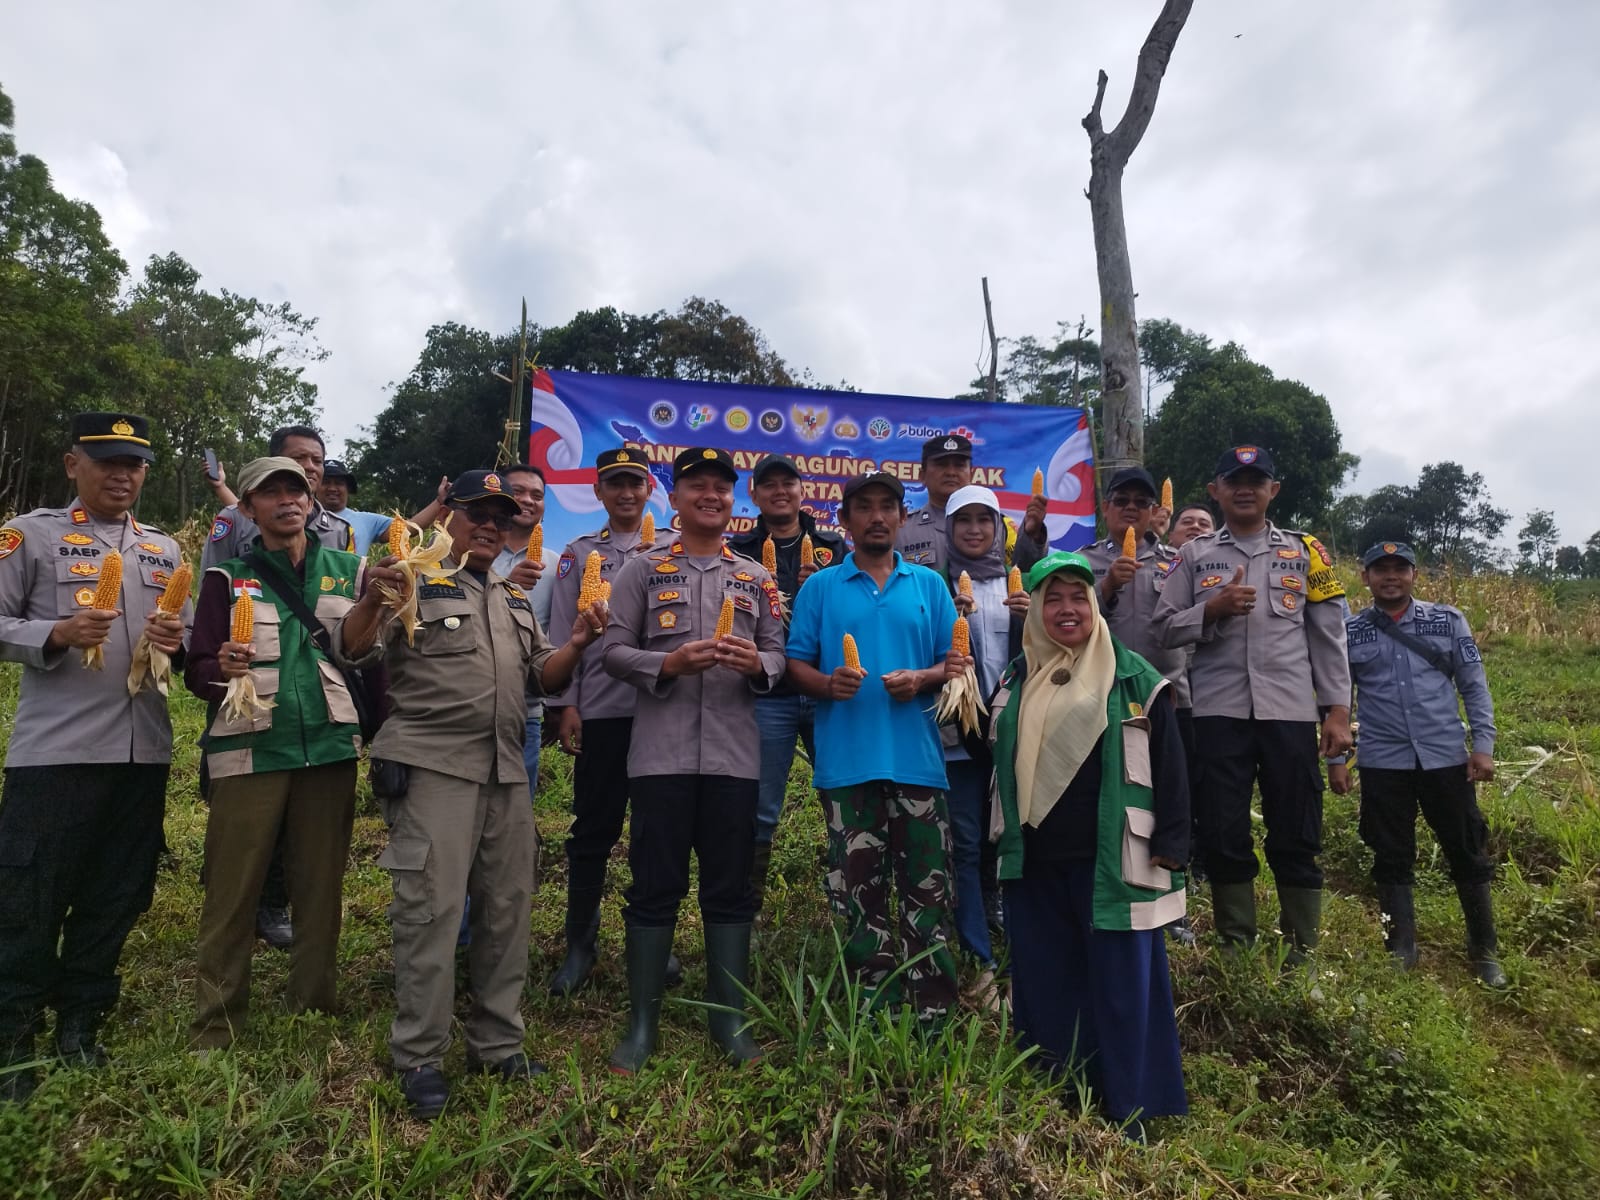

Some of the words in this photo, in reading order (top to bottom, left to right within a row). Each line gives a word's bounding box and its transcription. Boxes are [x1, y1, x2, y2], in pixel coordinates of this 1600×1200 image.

[785, 455, 876, 476] AGUNG
[59, 546, 101, 558] SAEP
[138, 554, 175, 569] POLRI
[1271, 561, 1306, 572] POLRI
[648, 575, 688, 587] ANGGY
[726, 580, 759, 597] POLRI
